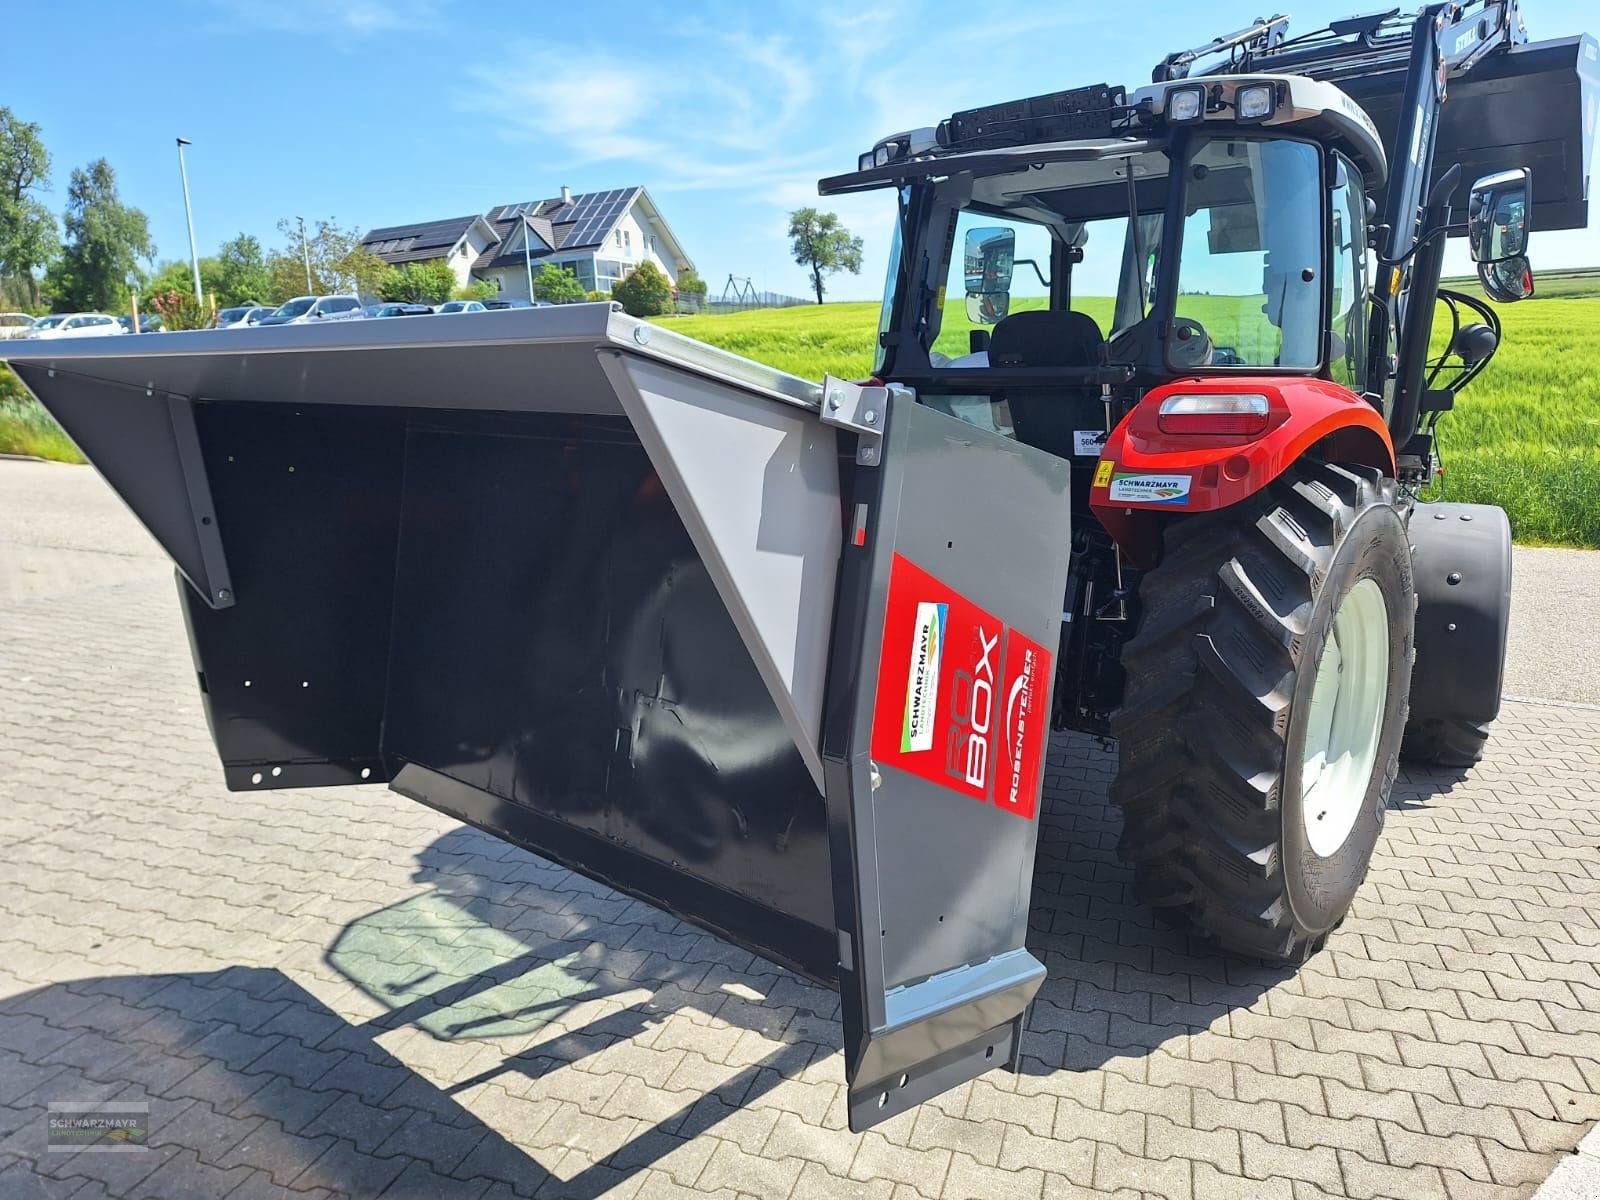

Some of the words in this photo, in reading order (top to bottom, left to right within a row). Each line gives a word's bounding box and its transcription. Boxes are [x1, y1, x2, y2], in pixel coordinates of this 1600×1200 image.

[1119, 479, 1179, 489] SCHWARZMAYR
[910, 624, 930, 738] SCHWARZMAYR
[918, 670, 931, 735] LANDTECHNIK
[945, 669, 973, 780] RO
[966, 625, 998, 789] BOX
[1009, 648, 1033, 803] ROSENSTEINER
